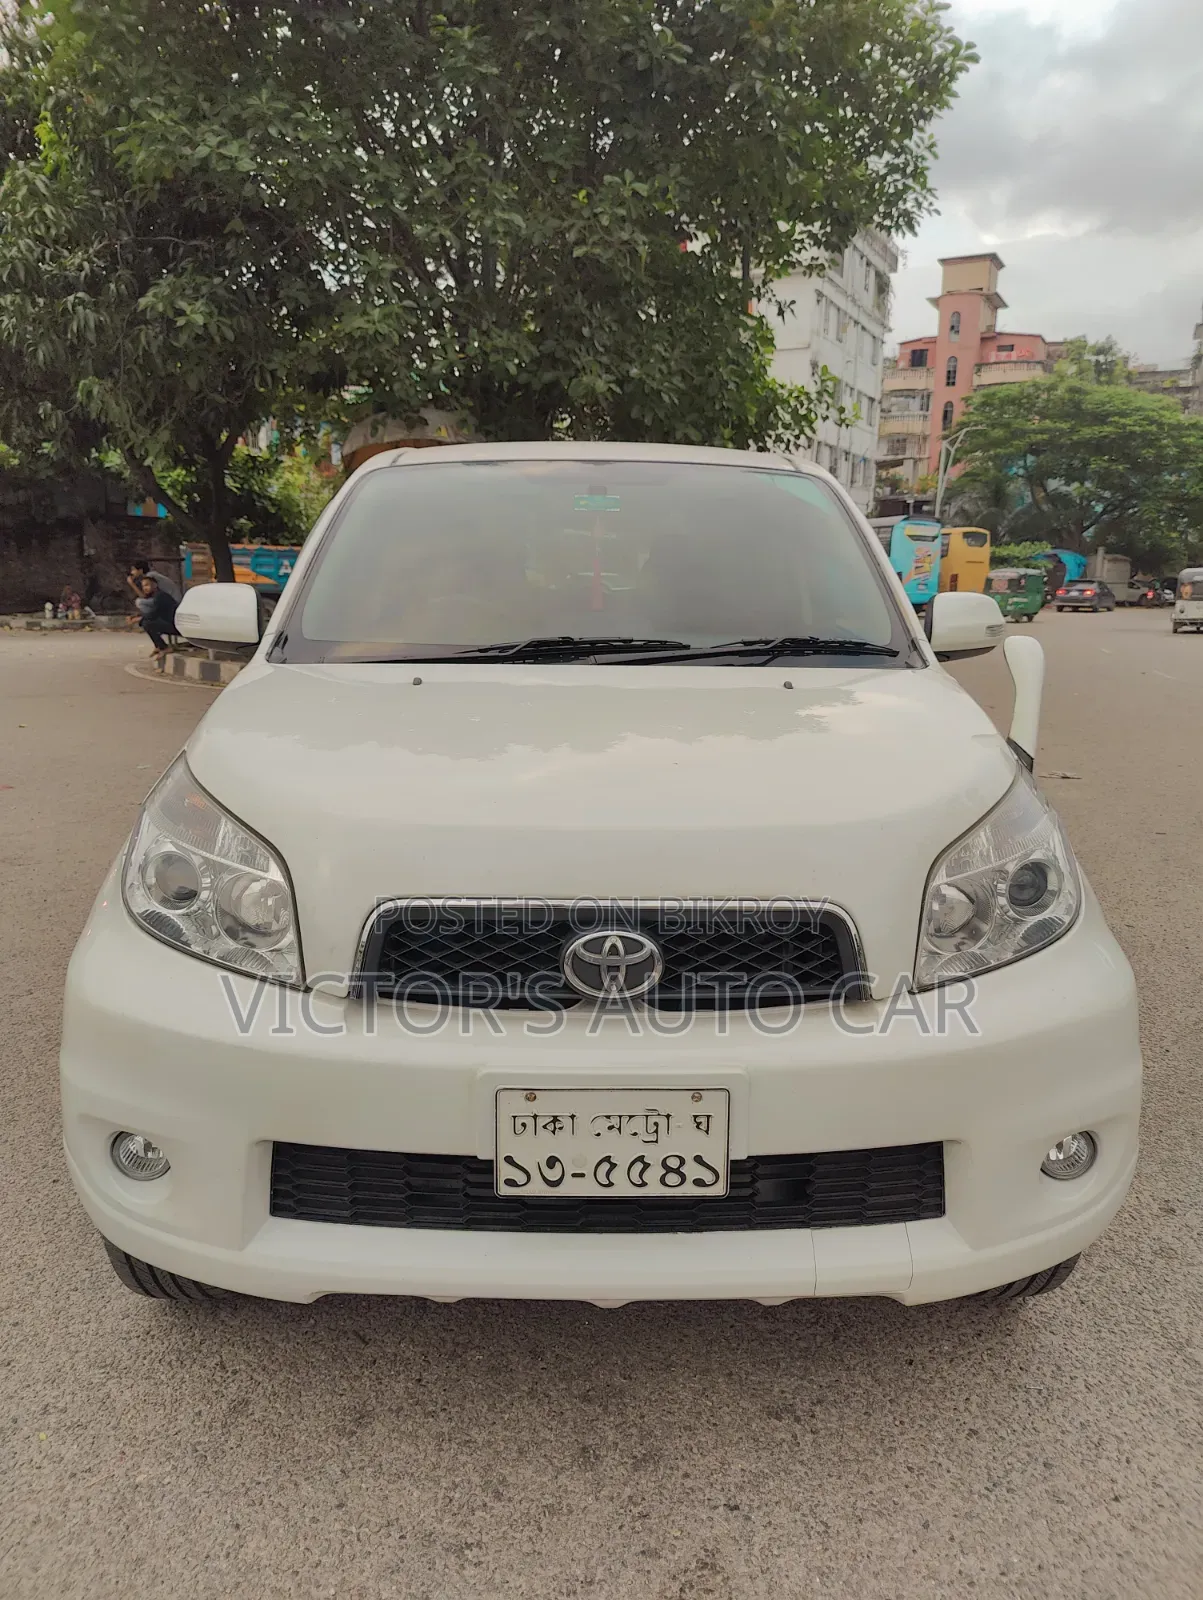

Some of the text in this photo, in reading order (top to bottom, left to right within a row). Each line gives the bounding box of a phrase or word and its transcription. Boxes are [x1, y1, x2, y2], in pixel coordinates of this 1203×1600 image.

[510, 1112, 578, 1137] ঢাকা
[691, 1114, 713, 1136] ঘ
[503, 1154, 721, 1188] ১৩-৫৫৪১
